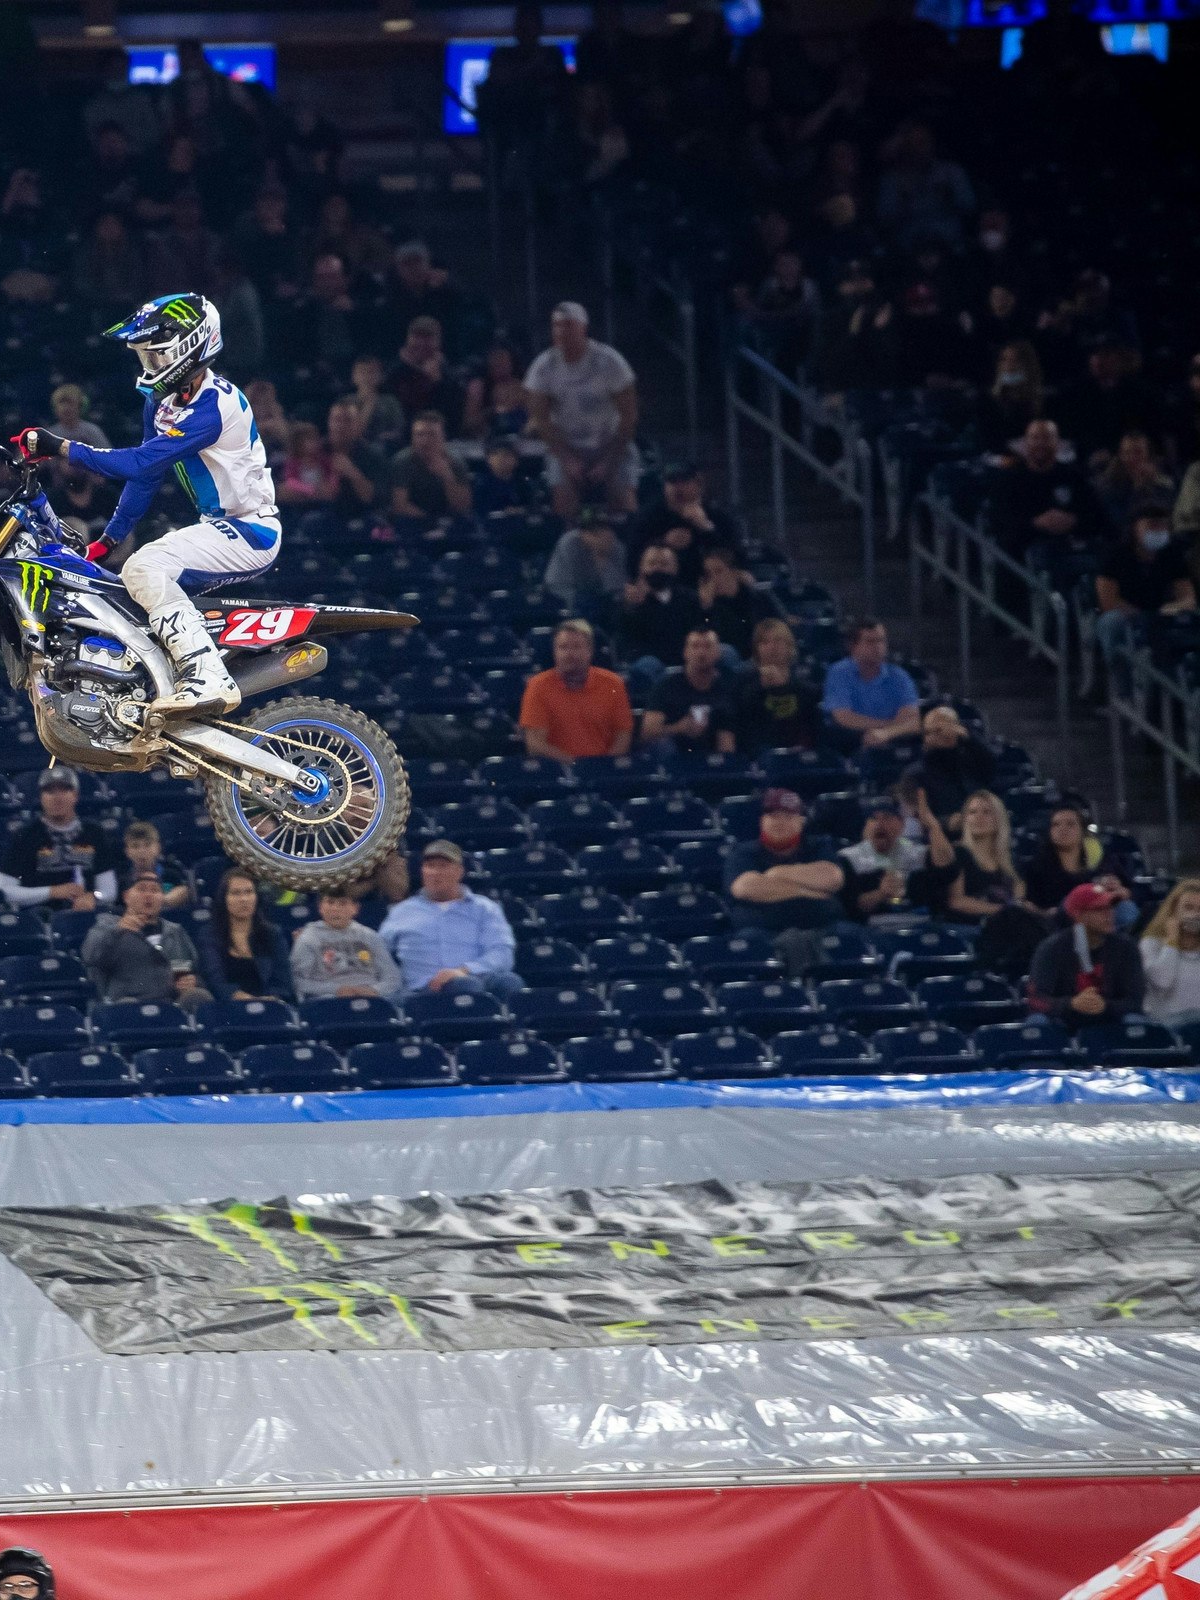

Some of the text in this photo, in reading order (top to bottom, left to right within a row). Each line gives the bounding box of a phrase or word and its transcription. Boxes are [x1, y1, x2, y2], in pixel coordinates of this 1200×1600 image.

[163, 357, 194, 383] MONSTER
[61, 570, 91, 587] YAMALUBE
[220, 599, 249, 607] YAMAHA
[224, 609, 295, 642] 29
